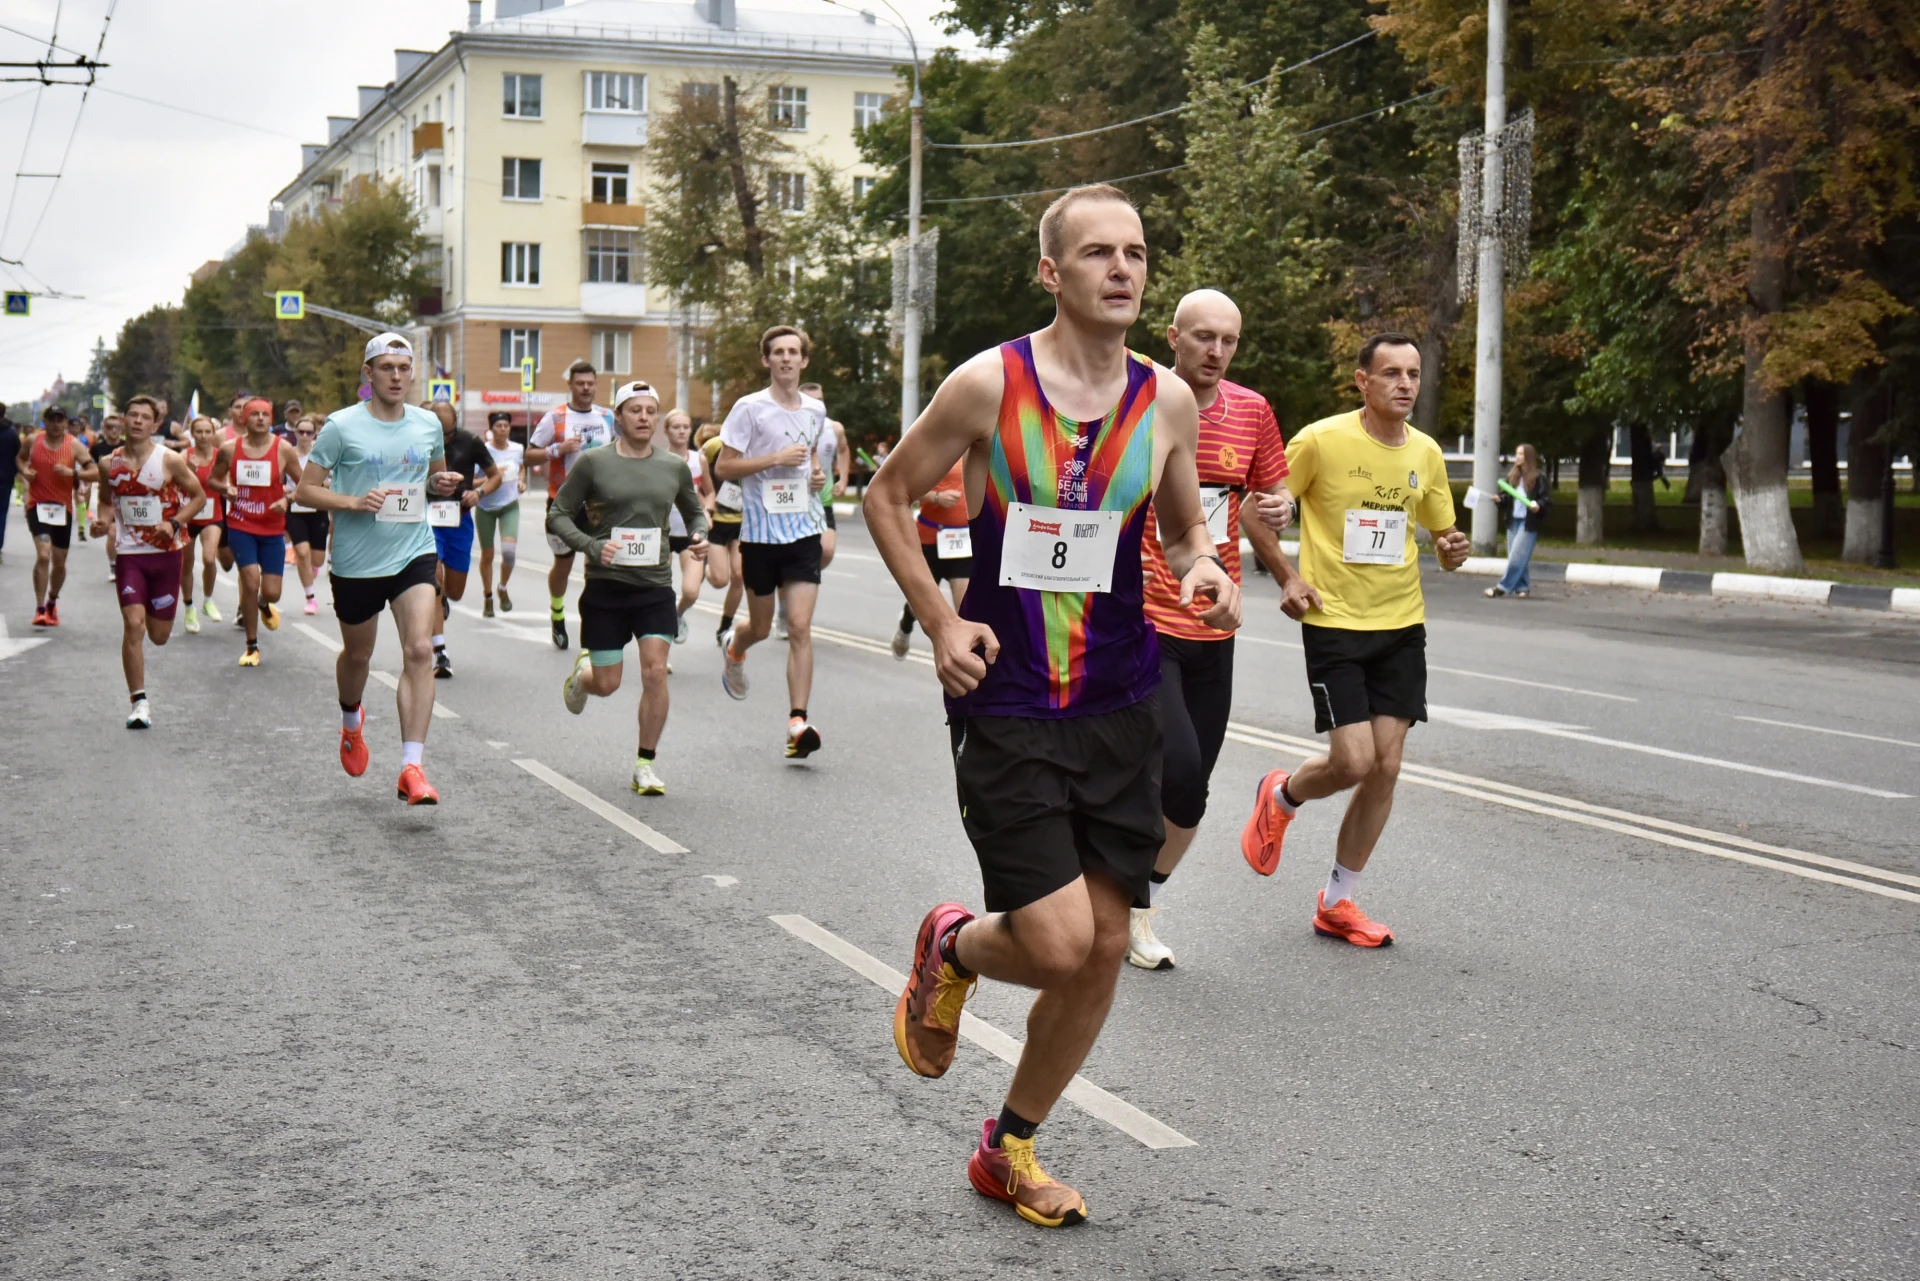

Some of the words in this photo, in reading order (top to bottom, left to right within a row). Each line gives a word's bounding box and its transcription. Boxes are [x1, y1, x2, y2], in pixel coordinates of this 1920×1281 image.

[245, 470, 260, 479] 489
[1058, 479, 1088, 492] БЕЛЫЕ
[776, 491, 794, 504] 384
[1056, 490, 1088, 503] НОЧИ
[397, 497, 409, 512] 12
[438, 510, 446, 519] 10
[949, 539, 963, 550] 210
[1371, 531, 1386, 549] 77
[627, 542, 645, 555] 130
[1051, 541, 1067, 569] 8
